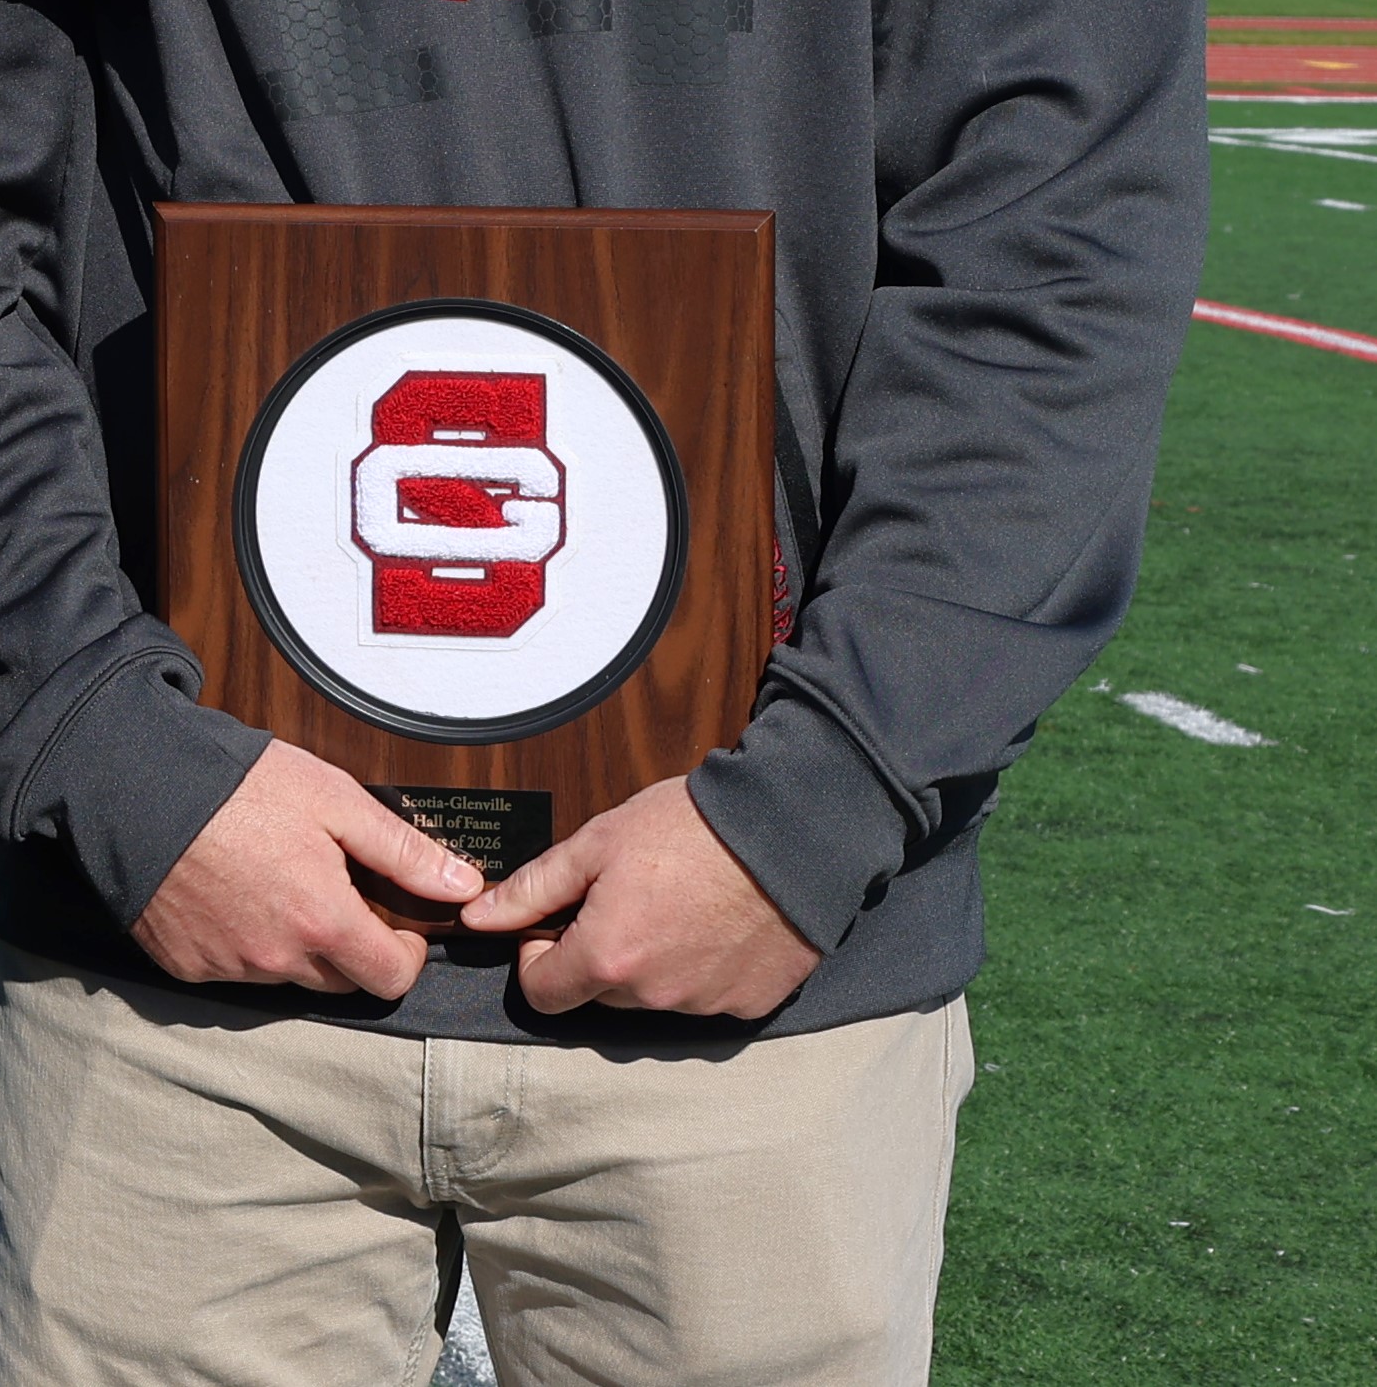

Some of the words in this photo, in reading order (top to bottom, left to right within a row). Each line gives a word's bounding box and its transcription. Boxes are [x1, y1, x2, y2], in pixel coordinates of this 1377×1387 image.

[401, 793, 513, 812] Scotia-Glenville
[413, 814, 443, 828] Hall
[446, 815, 463, 829] of
[463, 816, 501, 830] Fame
[450, 834, 466, 848] of
[467, 836, 502, 849] 2026
